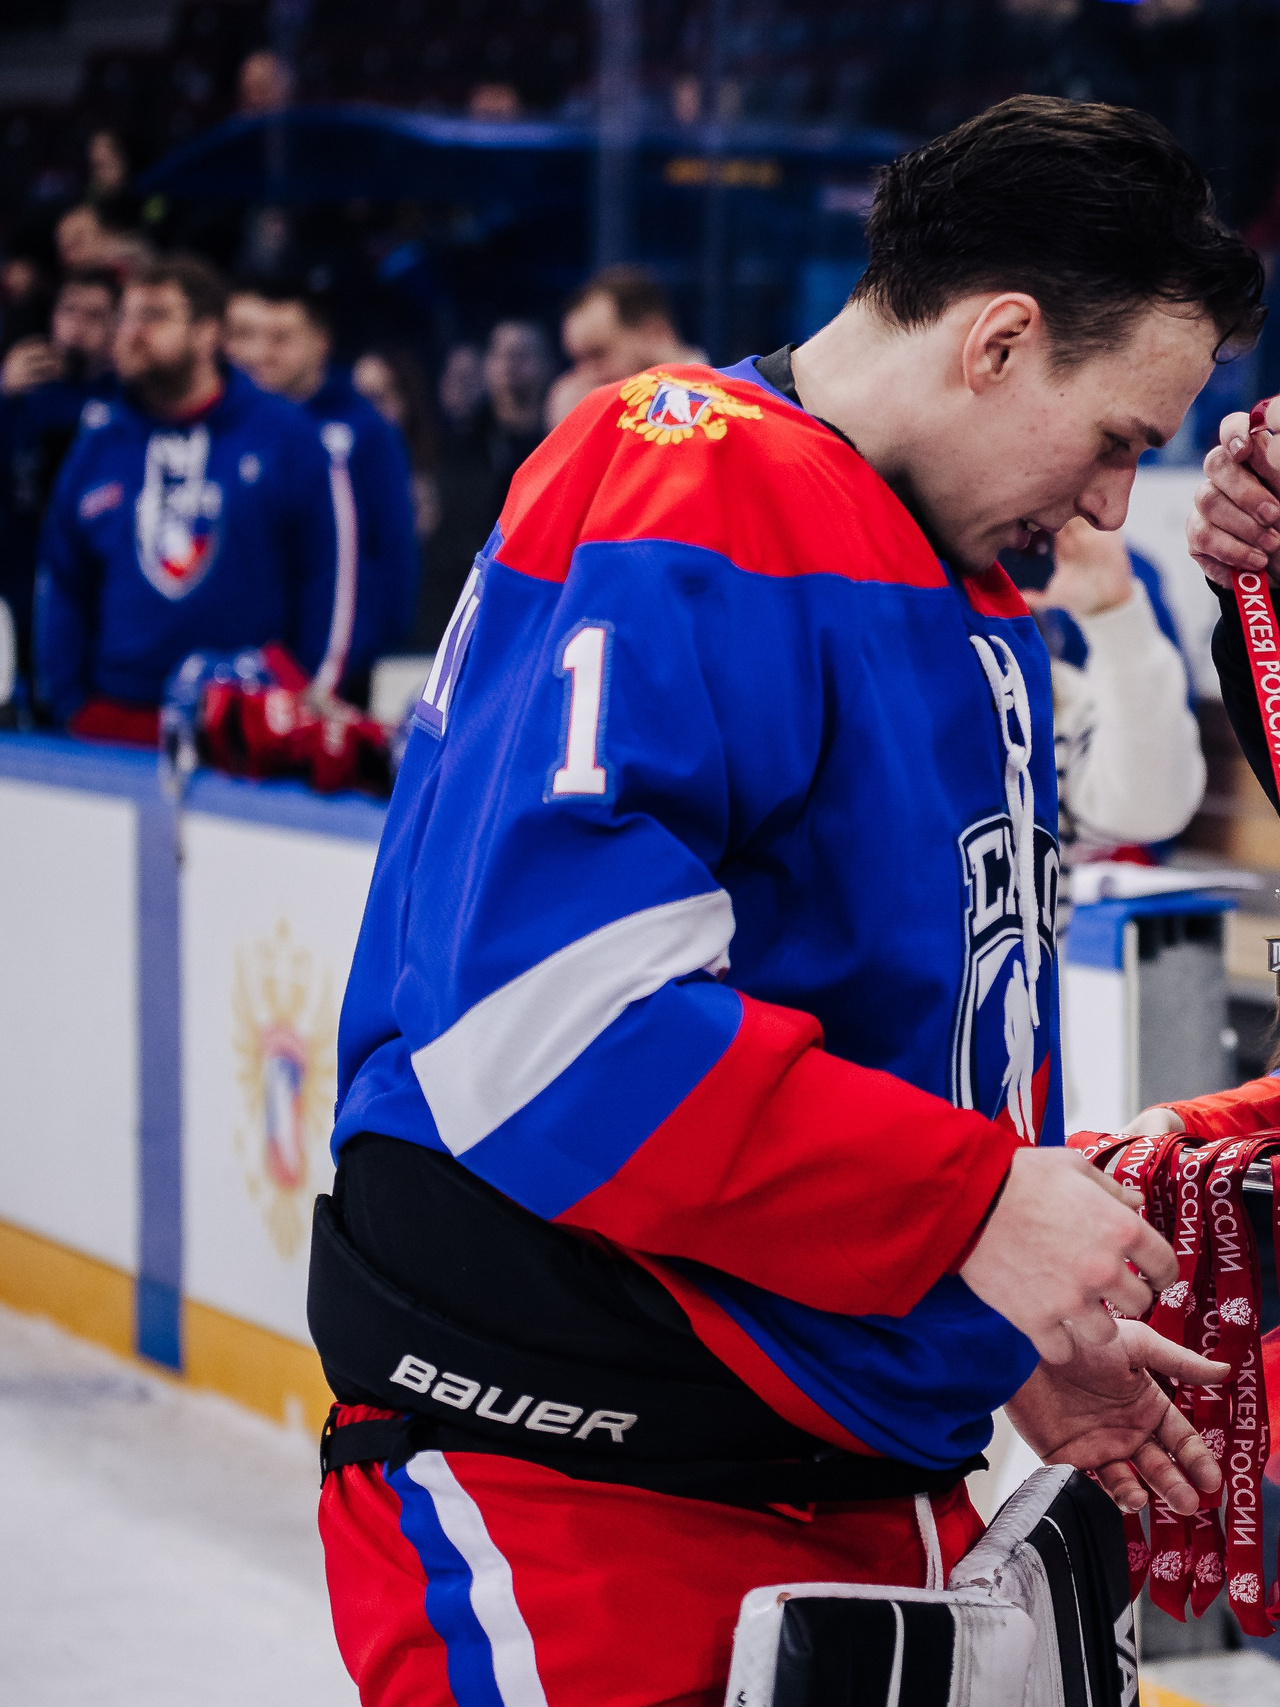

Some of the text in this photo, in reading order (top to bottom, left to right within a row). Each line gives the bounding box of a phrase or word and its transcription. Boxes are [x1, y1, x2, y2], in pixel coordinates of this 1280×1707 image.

[1238, 572, 1277, 653] ОККЕЯ
[552, 624, 606, 796] 1
[1177, 1150, 1209, 1256] РОССИИ
[1209, 1164, 1244, 1273] РОССИИ
[1230, 1438, 1256, 1546] РОССИИ
